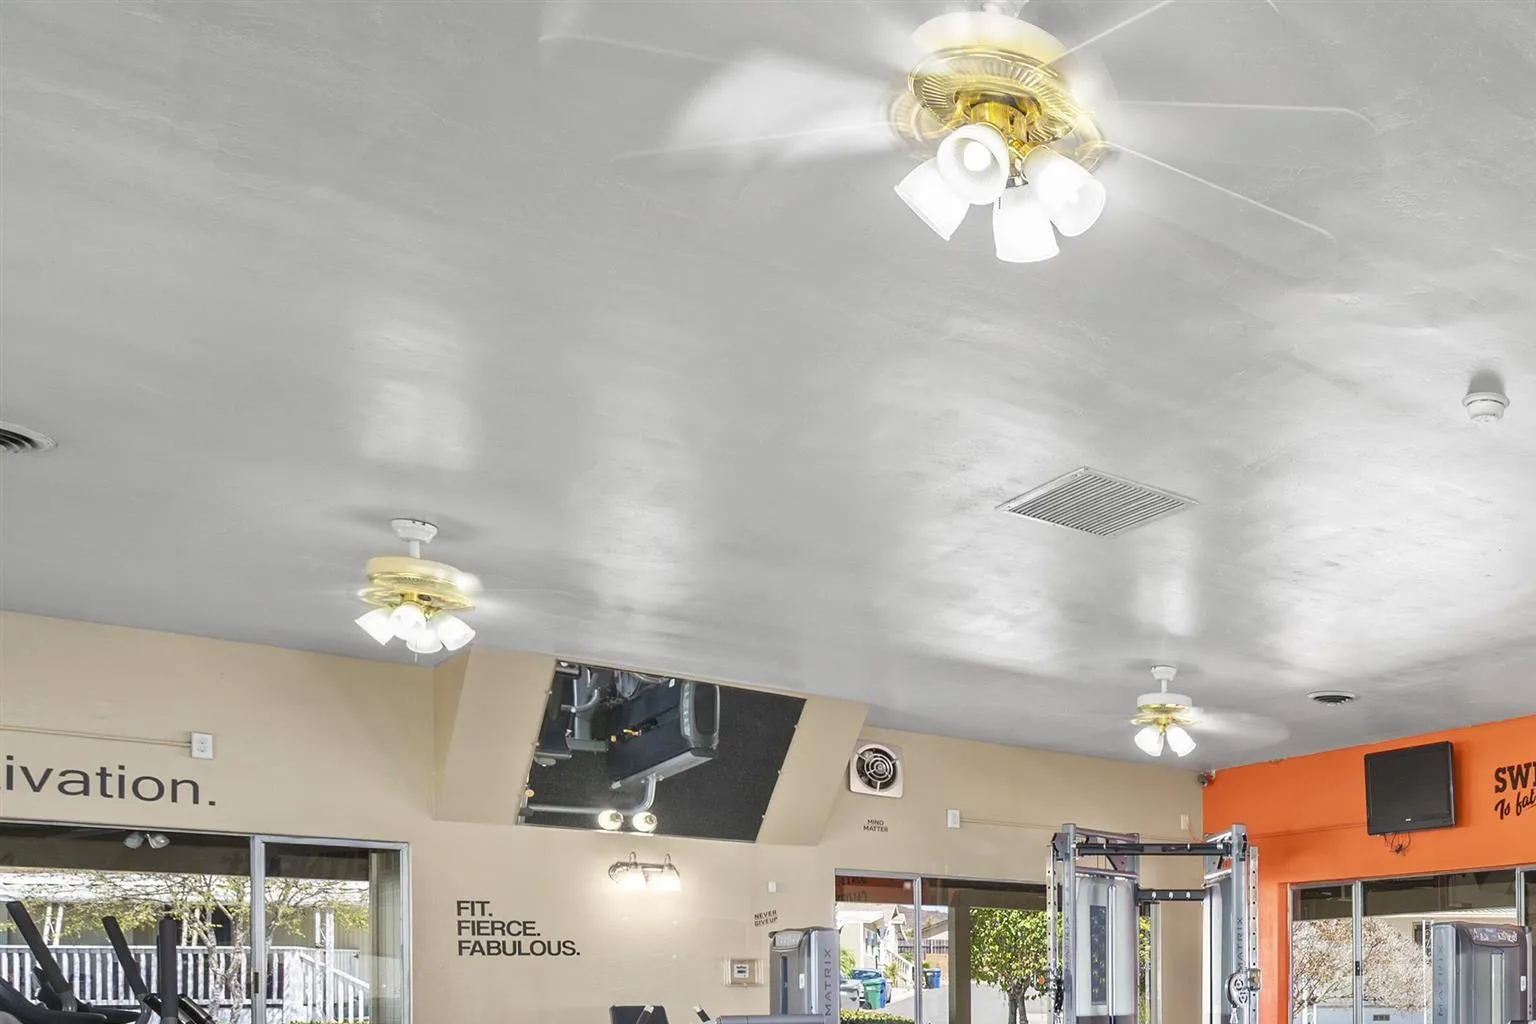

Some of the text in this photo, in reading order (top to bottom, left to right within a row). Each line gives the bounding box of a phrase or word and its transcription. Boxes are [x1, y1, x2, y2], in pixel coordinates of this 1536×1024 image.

[0, 754, 216, 806] ivation.
[1494, 798, 1511, 820] Is
[1516, 788, 1536, 816] fat
[456, 900, 493, 917] FIT.
[754, 910, 776, 919] NEVER
[457, 920, 541, 936] FIERCE.
[458, 940, 581, 956] FABULOUS.
